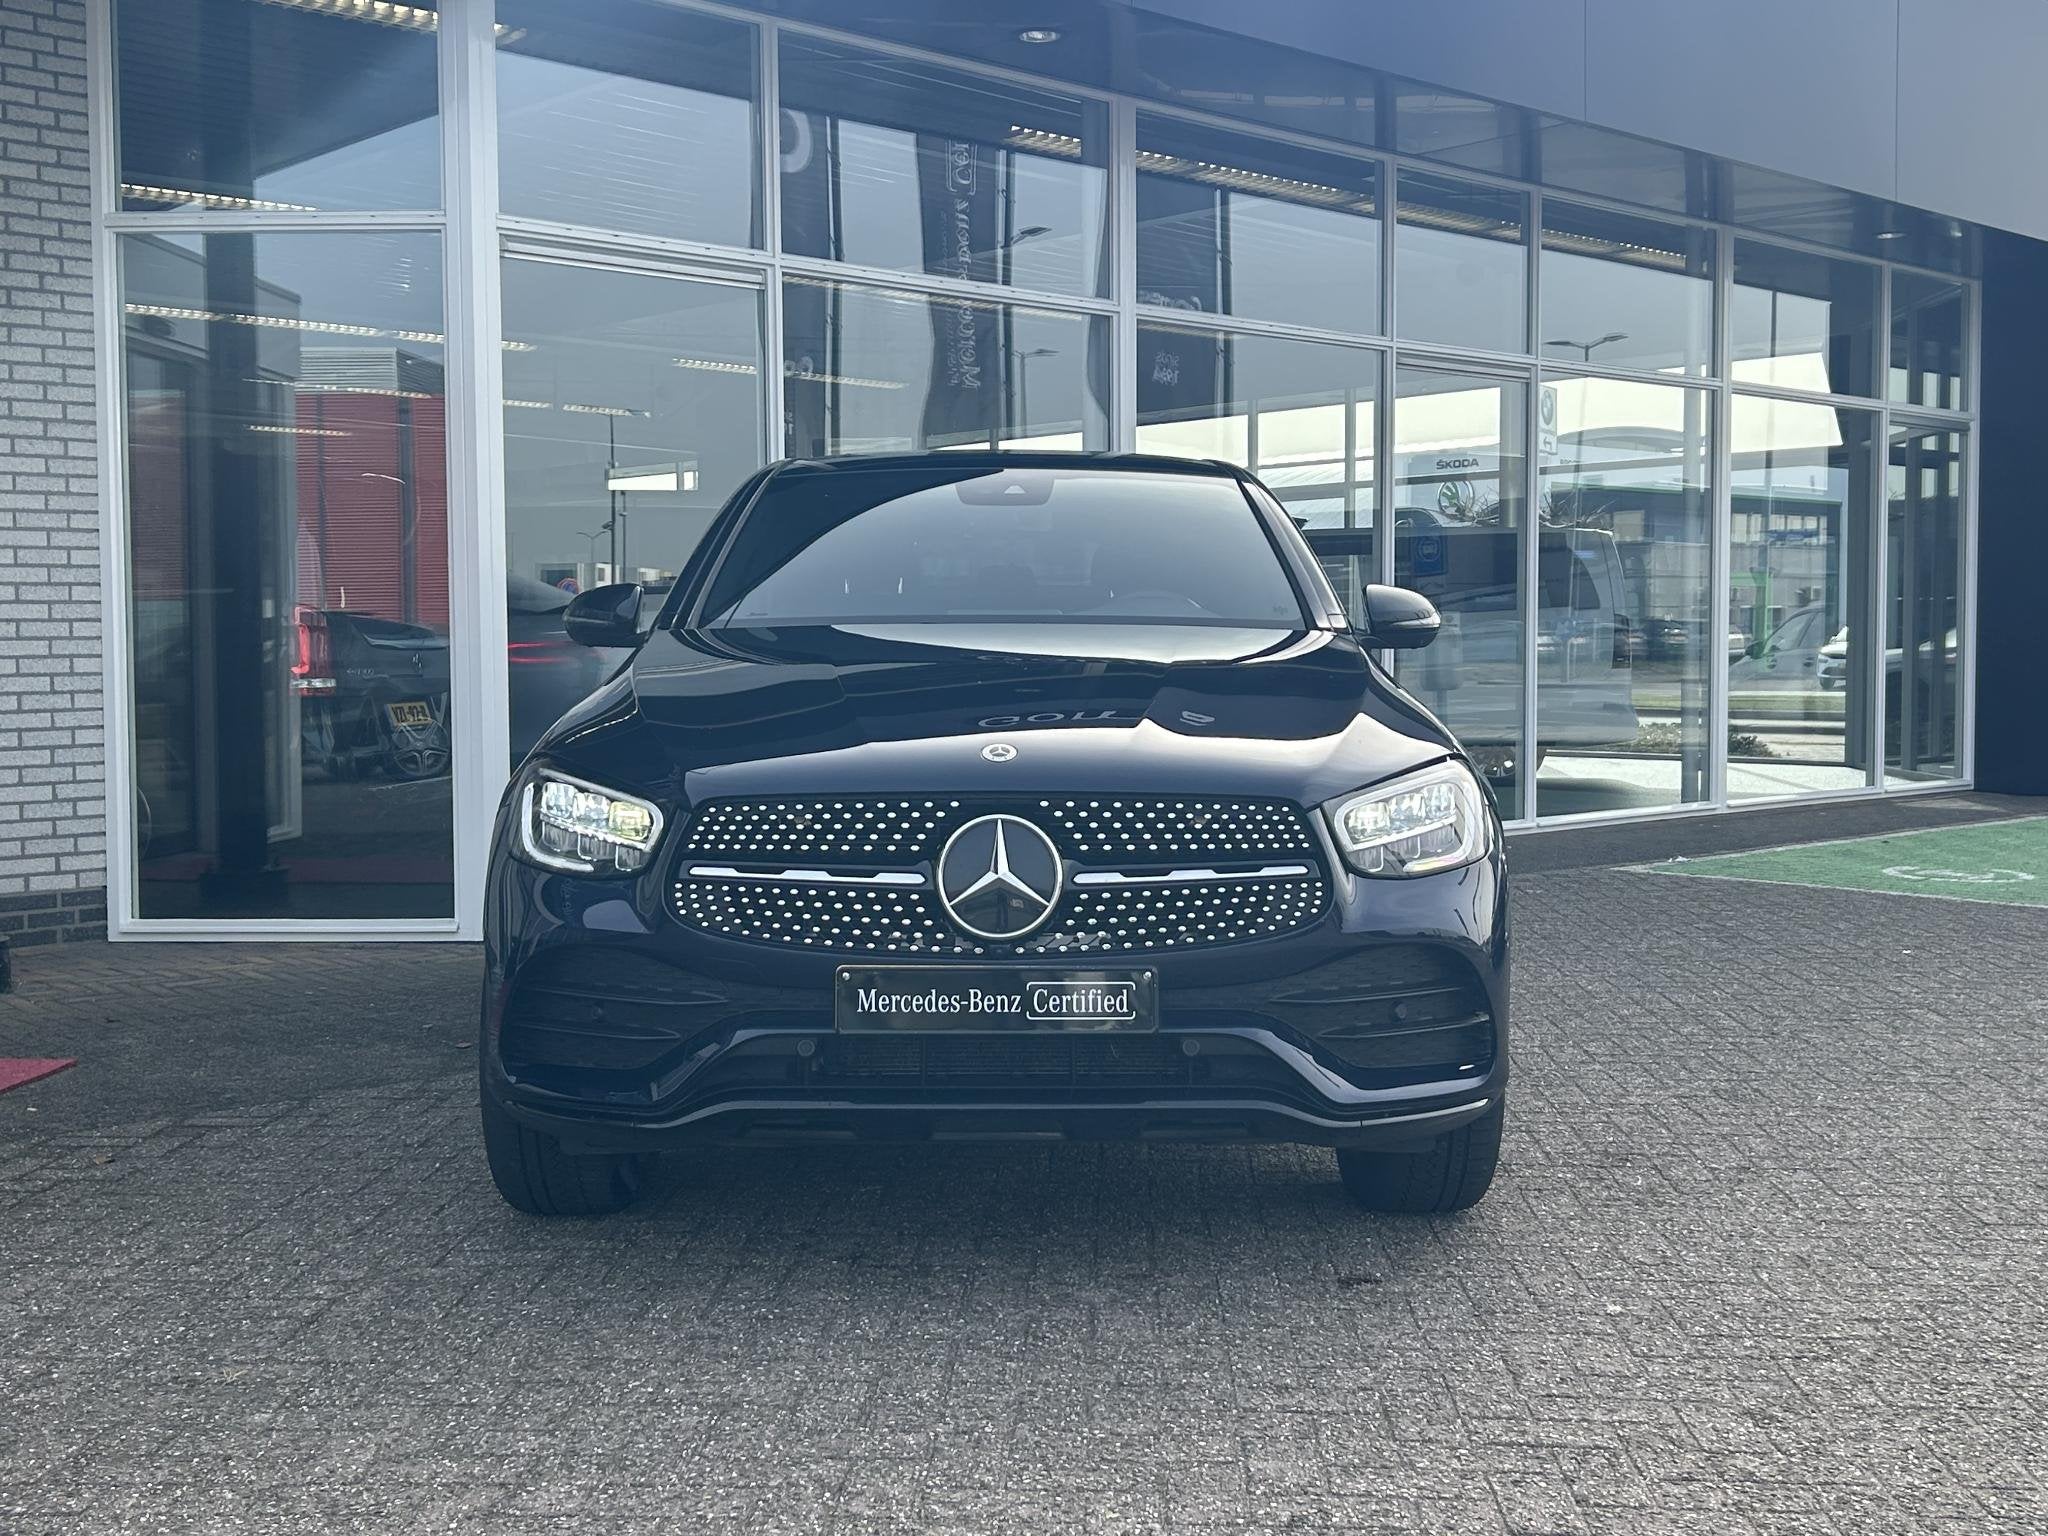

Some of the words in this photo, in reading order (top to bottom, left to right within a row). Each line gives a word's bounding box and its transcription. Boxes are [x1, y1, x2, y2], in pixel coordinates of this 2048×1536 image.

[1436, 457, 1480, 470] ŠKODA
[856, 988, 1022, 1013] Mercedes-Benz
[1033, 988, 1130, 1013] Certified
